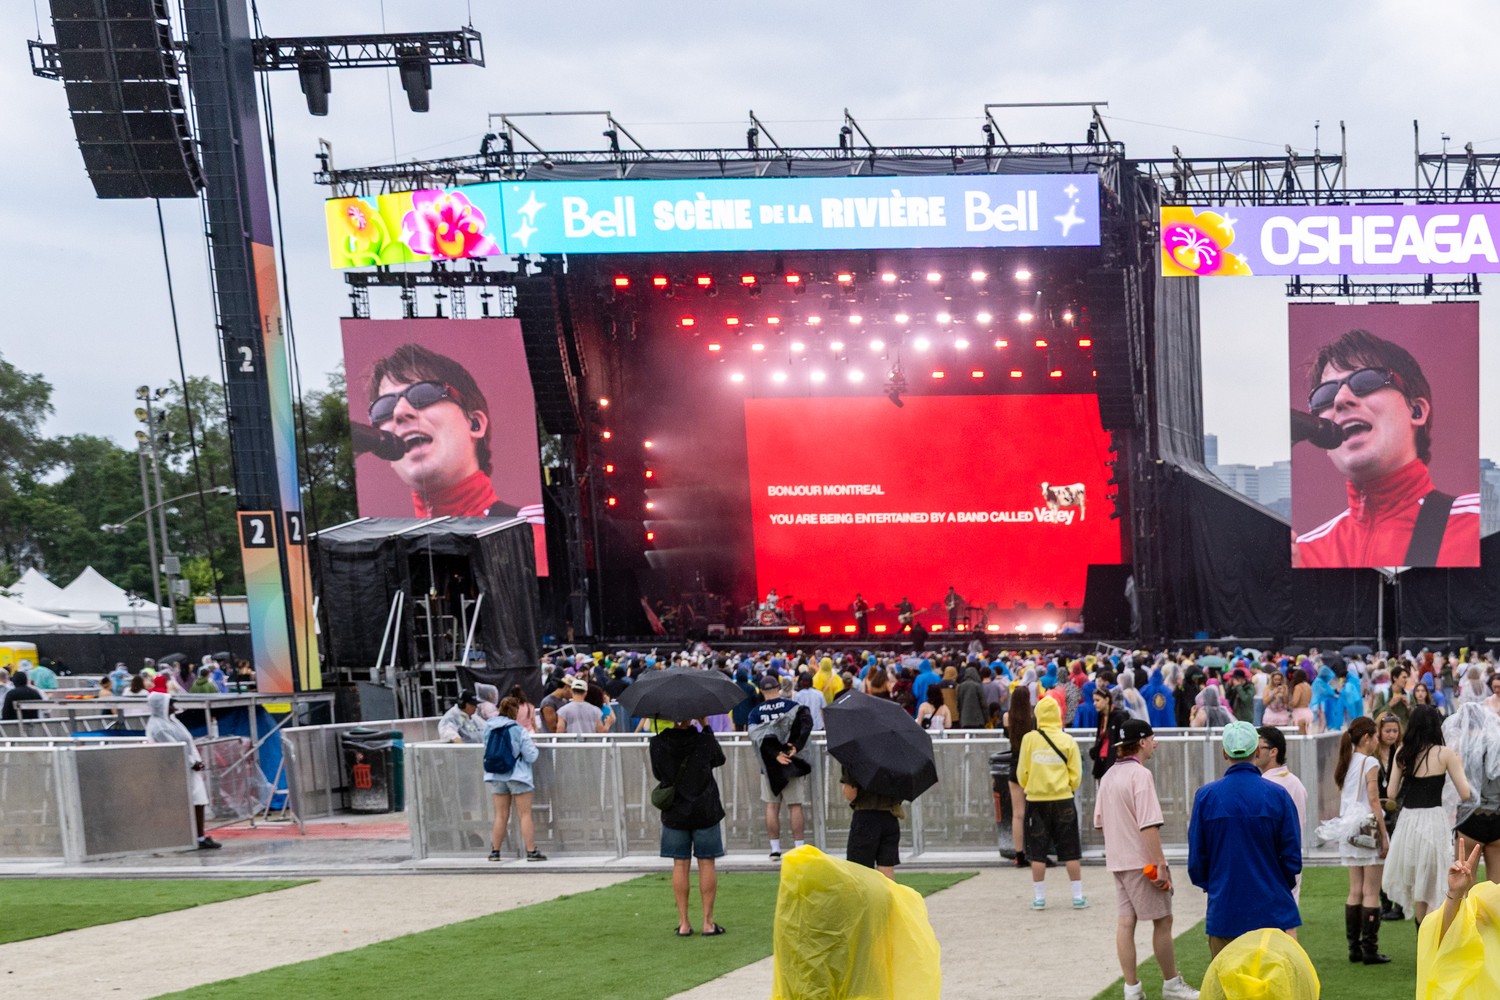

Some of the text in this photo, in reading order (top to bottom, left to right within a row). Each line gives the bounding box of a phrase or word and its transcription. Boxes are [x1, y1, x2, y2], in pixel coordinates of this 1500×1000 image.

[562, 196, 637, 238] Bell
[652, 188, 947, 231] SCÈNE DE LA RIVIÈRE
[963, 189, 1039, 232] Bell
[1260, 214, 1500, 266] OSHEAGA
[237, 346, 255, 373] 2
[767, 484, 885, 497] BONJOUR MONTREAL
[249, 518, 267, 545] 2
[290, 515, 302, 541] 2
[769, 513, 794, 525] YOU
[795, 513, 818, 525] ARE
[819, 512, 853, 524] BEING
[854, 511, 929, 524] ENTERTAINED
[930, 512, 946, 523] BY
[947, 512, 955, 522] A
[957, 511, 989, 522] BAND
[989, 511, 1034, 522] CALLED
